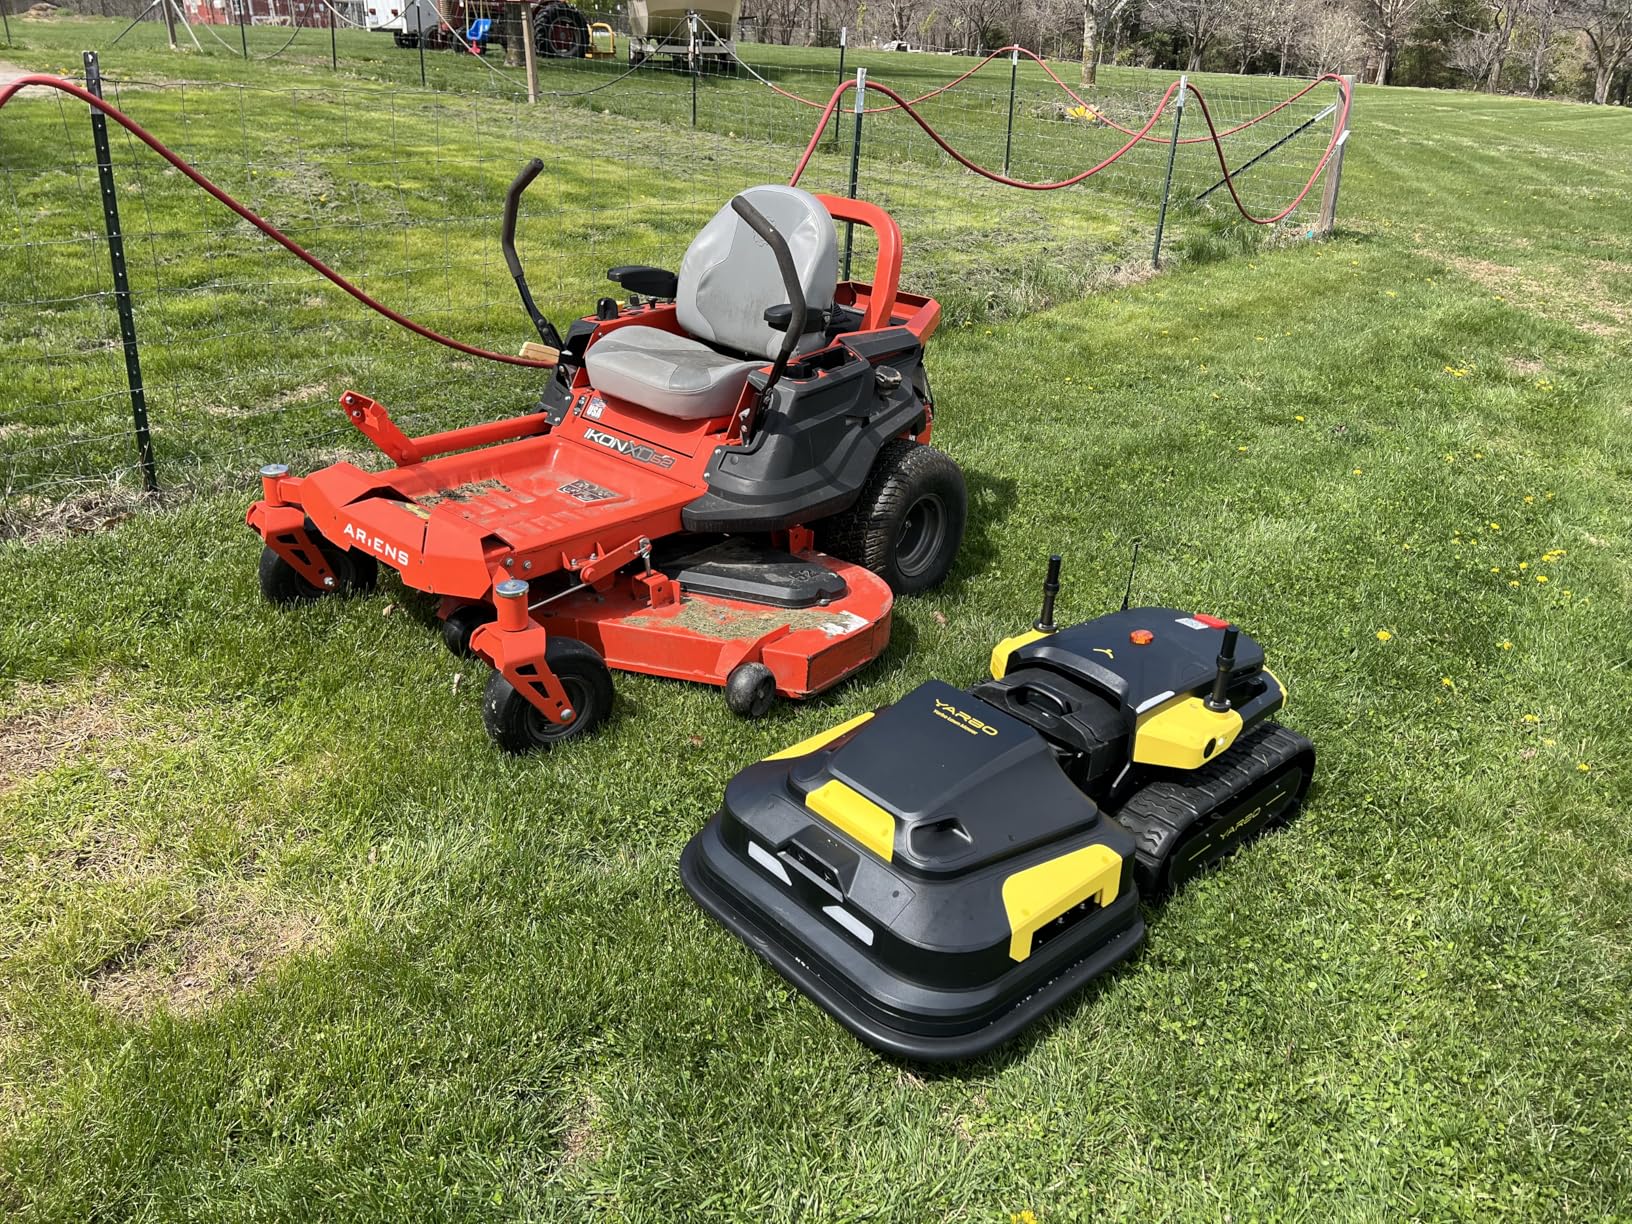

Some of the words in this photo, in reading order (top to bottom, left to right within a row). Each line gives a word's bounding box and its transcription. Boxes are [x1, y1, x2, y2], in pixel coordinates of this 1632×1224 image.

[586, 404, 603, 419] USA
[935, 698, 999, 736] YARBO
[1219, 806, 1262, 840] YARBO
